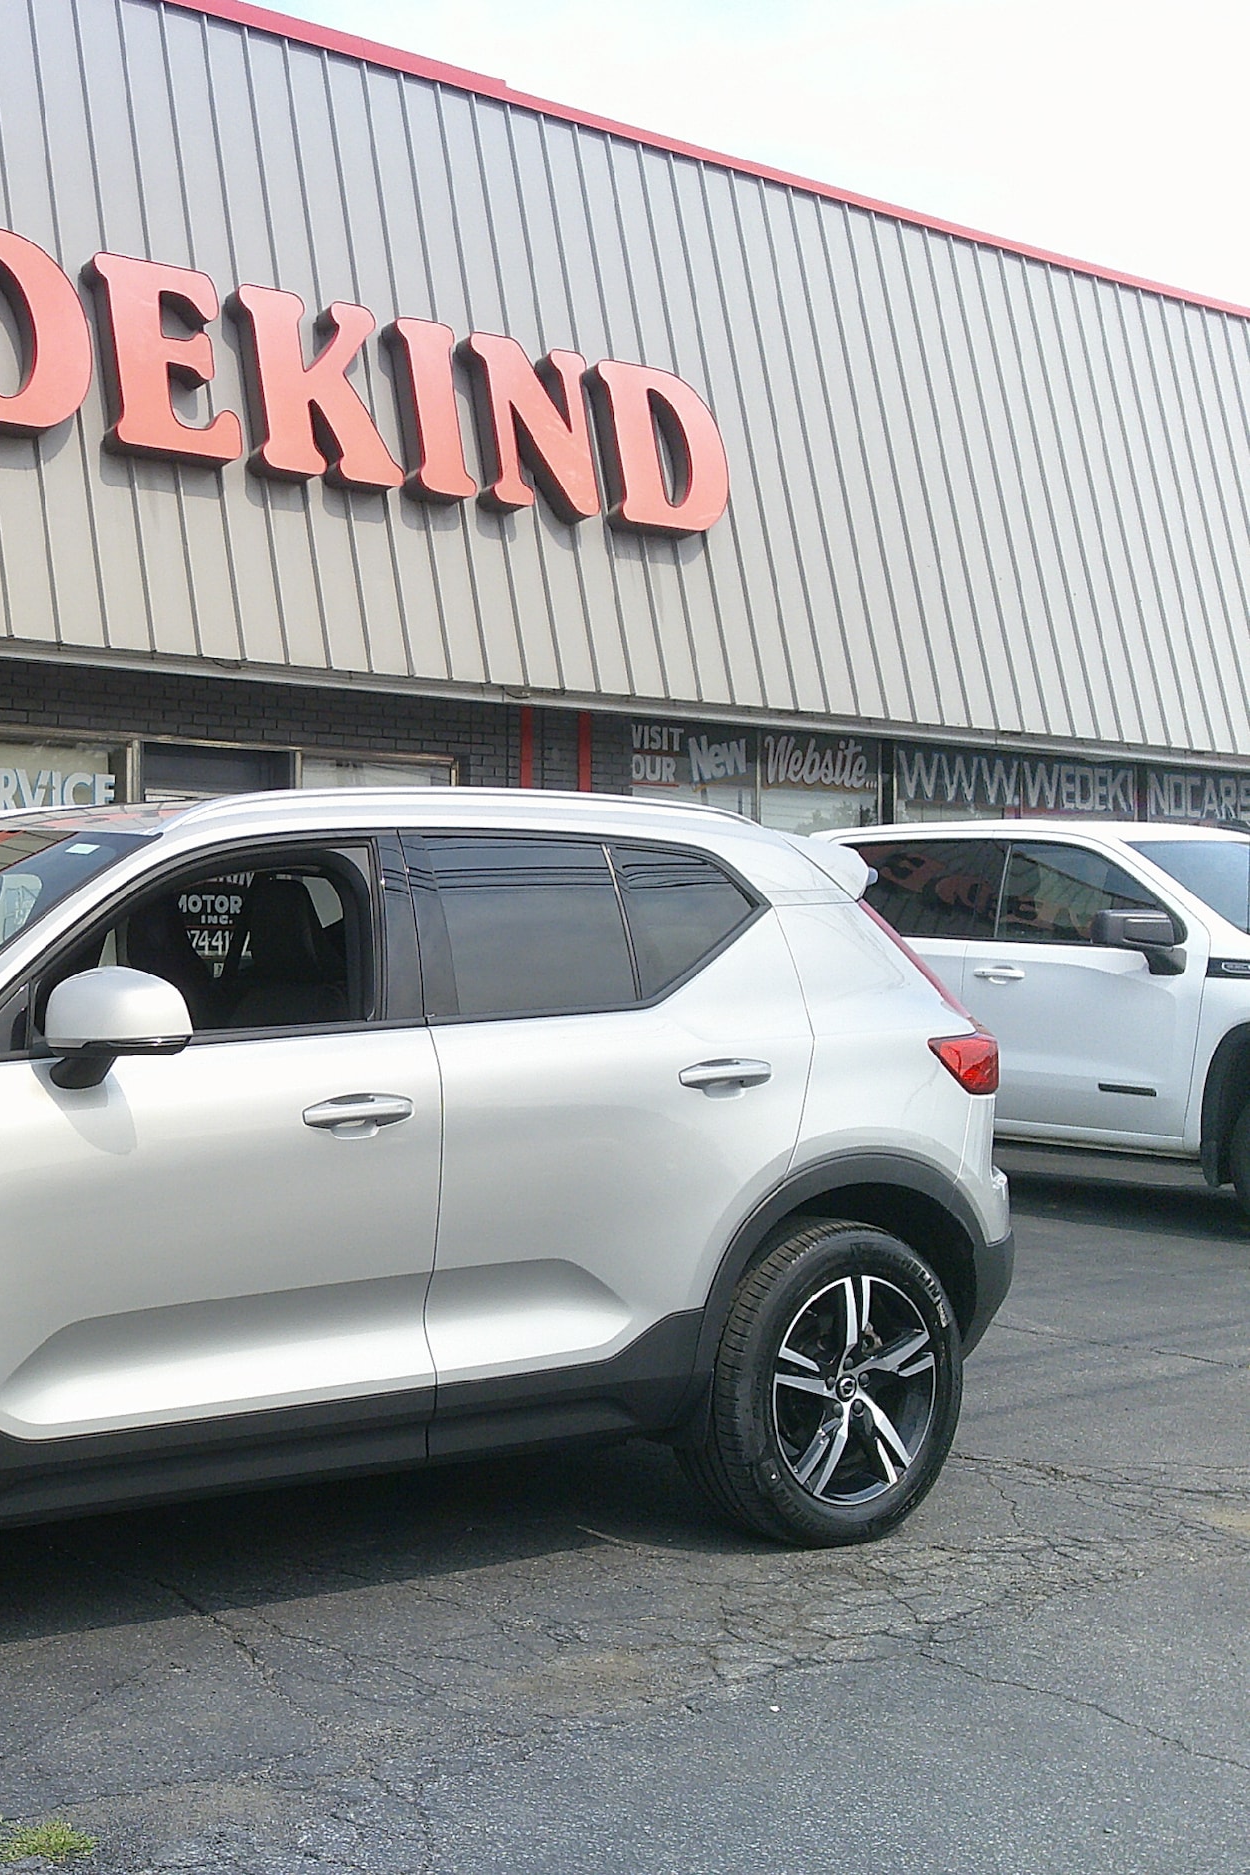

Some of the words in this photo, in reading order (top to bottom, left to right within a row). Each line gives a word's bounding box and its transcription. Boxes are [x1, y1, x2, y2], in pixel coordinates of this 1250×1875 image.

[631, 724, 684, 751] VISIT
[632, 754, 676, 783] OUR
[688, 735, 747, 784] New
[200, 914, 233, 925] INC.
